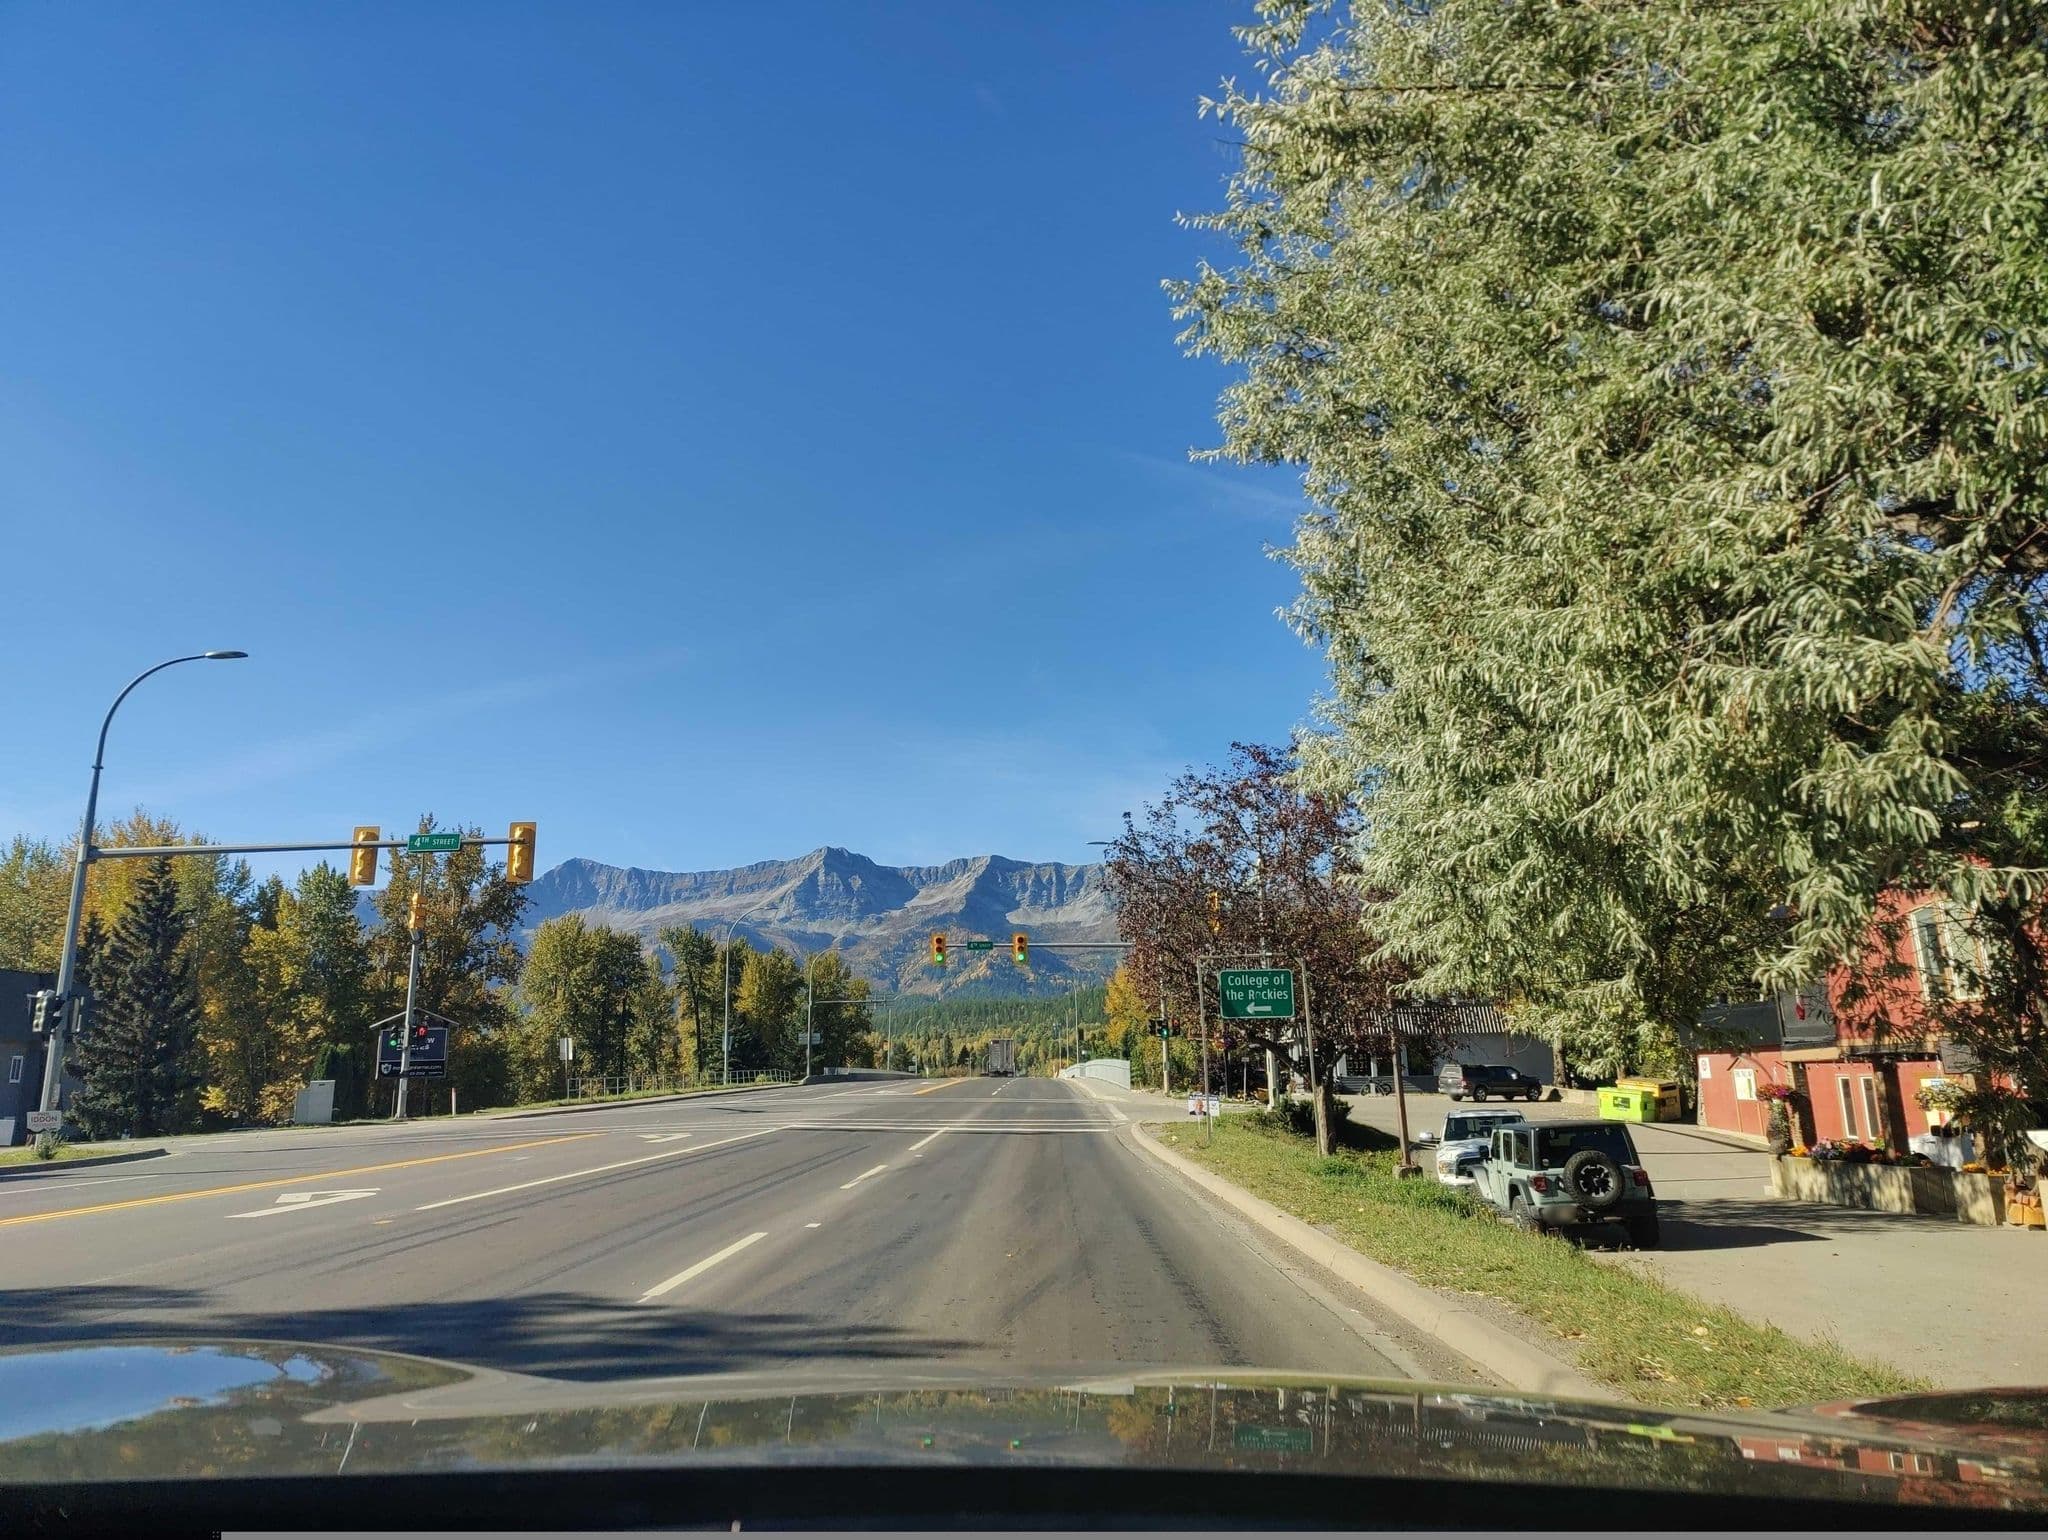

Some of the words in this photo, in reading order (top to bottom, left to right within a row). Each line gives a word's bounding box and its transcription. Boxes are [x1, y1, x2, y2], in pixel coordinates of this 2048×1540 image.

[414, 837, 430, 847] 4TH
[1227, 974, 1269, 988] College
[1273, 974, 1285, 985] of
[1225, 989, 1245, 1000] the
